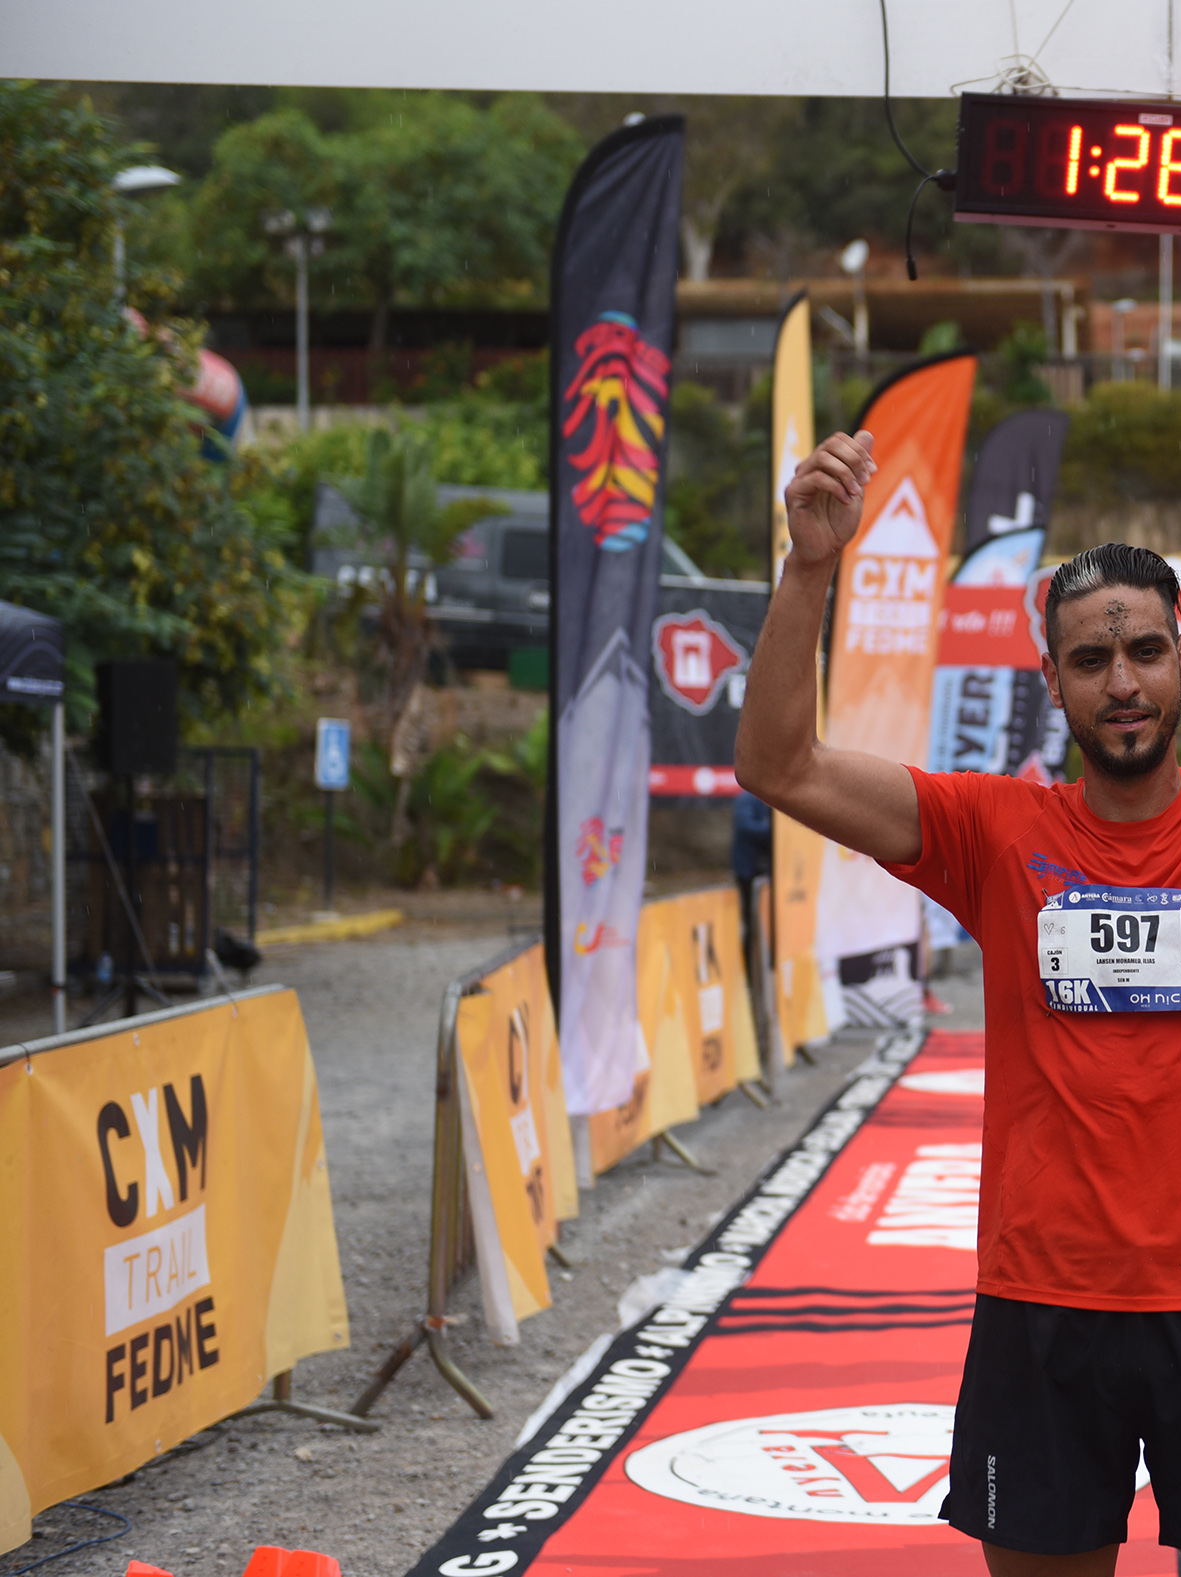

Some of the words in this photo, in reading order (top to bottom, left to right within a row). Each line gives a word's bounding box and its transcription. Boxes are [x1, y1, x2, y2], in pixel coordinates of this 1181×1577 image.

[851, 558, 937, 600] CXM
[1090, 912, 1161, 954] 597
[1045, 979, 1091, 1005] 16K
[1050, 957, 1060, 972] 3
[1053, 1003, 1099, 1012] INDIVIDUAL
[97, 1073, 209, 1229] CXM
[122, 1226, 198, 1311] TRAIL
[104, 1296, 220, 1425] FEDME
[483, 1357, 673, 1521] SENDERISMO
[985, 1454, 996, 1530] SALOMON
